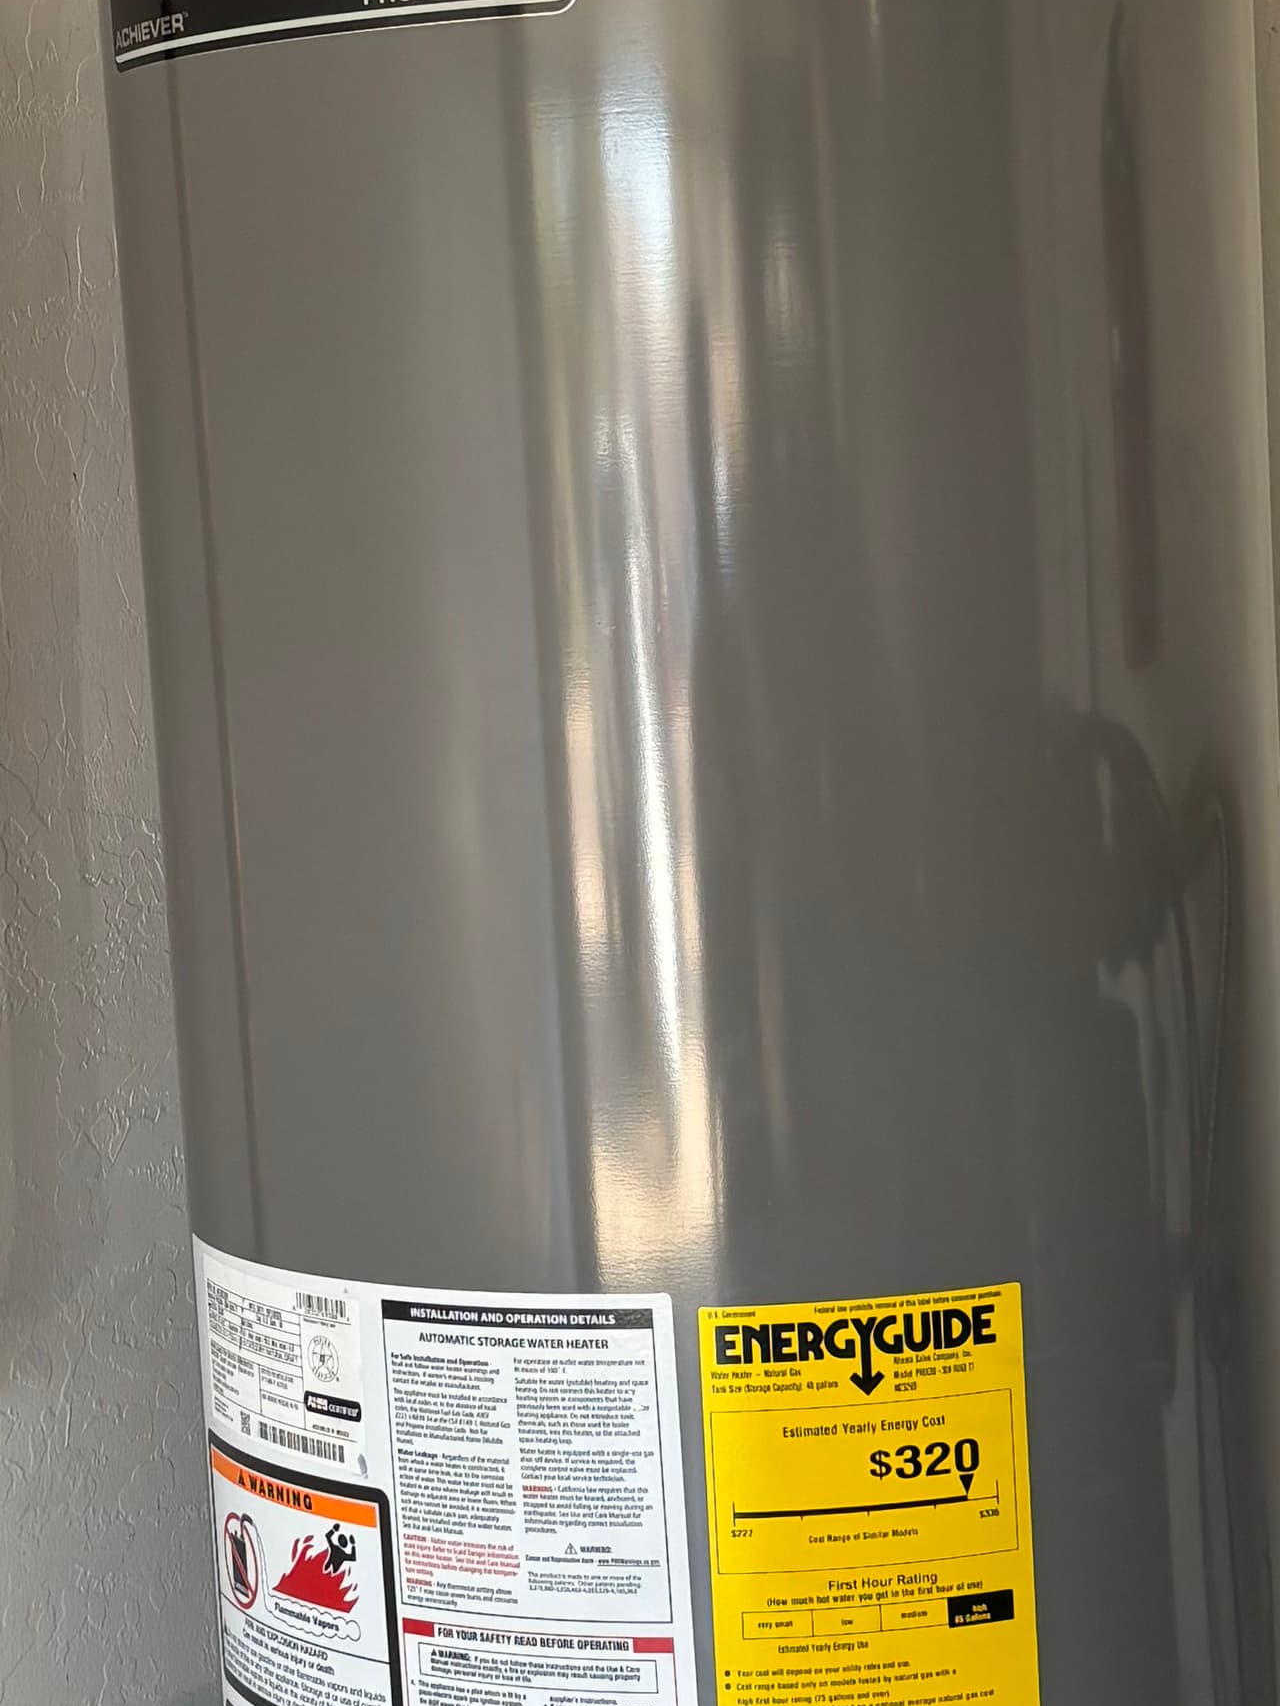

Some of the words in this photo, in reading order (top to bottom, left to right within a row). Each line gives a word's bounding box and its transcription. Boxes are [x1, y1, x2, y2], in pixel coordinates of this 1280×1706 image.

[410, 1308, 478, 1322] INSTALLATION
[480, 1313, 504, 1323] AND
[505, 1314, 568, 1325] OPERATION
[570, 1314, 616, 1325] DETAILS
[419, 1333, 476, 1346] AUTOMATIC
[477, 1336, 526, 1347] STORAGE
[526, 1338, 564, 1349] WATER
[566, 1339, 609, 1350] HEATER
[714, 1304, 997, 1365] ENERGYGUIDE
[783, 1424, 837, 1438] Estimated
[842, 1421, 876, 1434] Yearly
[881, 1419, 918, 1431] Energy
[922, 1415, 945, 1427] Cost
[870, 1438, 980, 1480] $320
[248, 1475, 313, 1510] WARNING
[828, 1580, 857, 1591] First
[862, 1577, 893, 1589] Hour
[897, 1573, 938, 1585] Rating
[816, 1595, 830, 1603] hot
[832, 1594, 855, 1603] water
[858, 1593, 873, 1602] you
[438, 1627, 454, 1638] FOR
[456, 1630, 478, 1642] YOUR
[479, 1631, 511, 1644] SAFETY
[514, 1635, 538, 1647] READ
[540, 1637, 575, 1649] BEFORE
[577, 1640, 629, 1651] OPERATING
